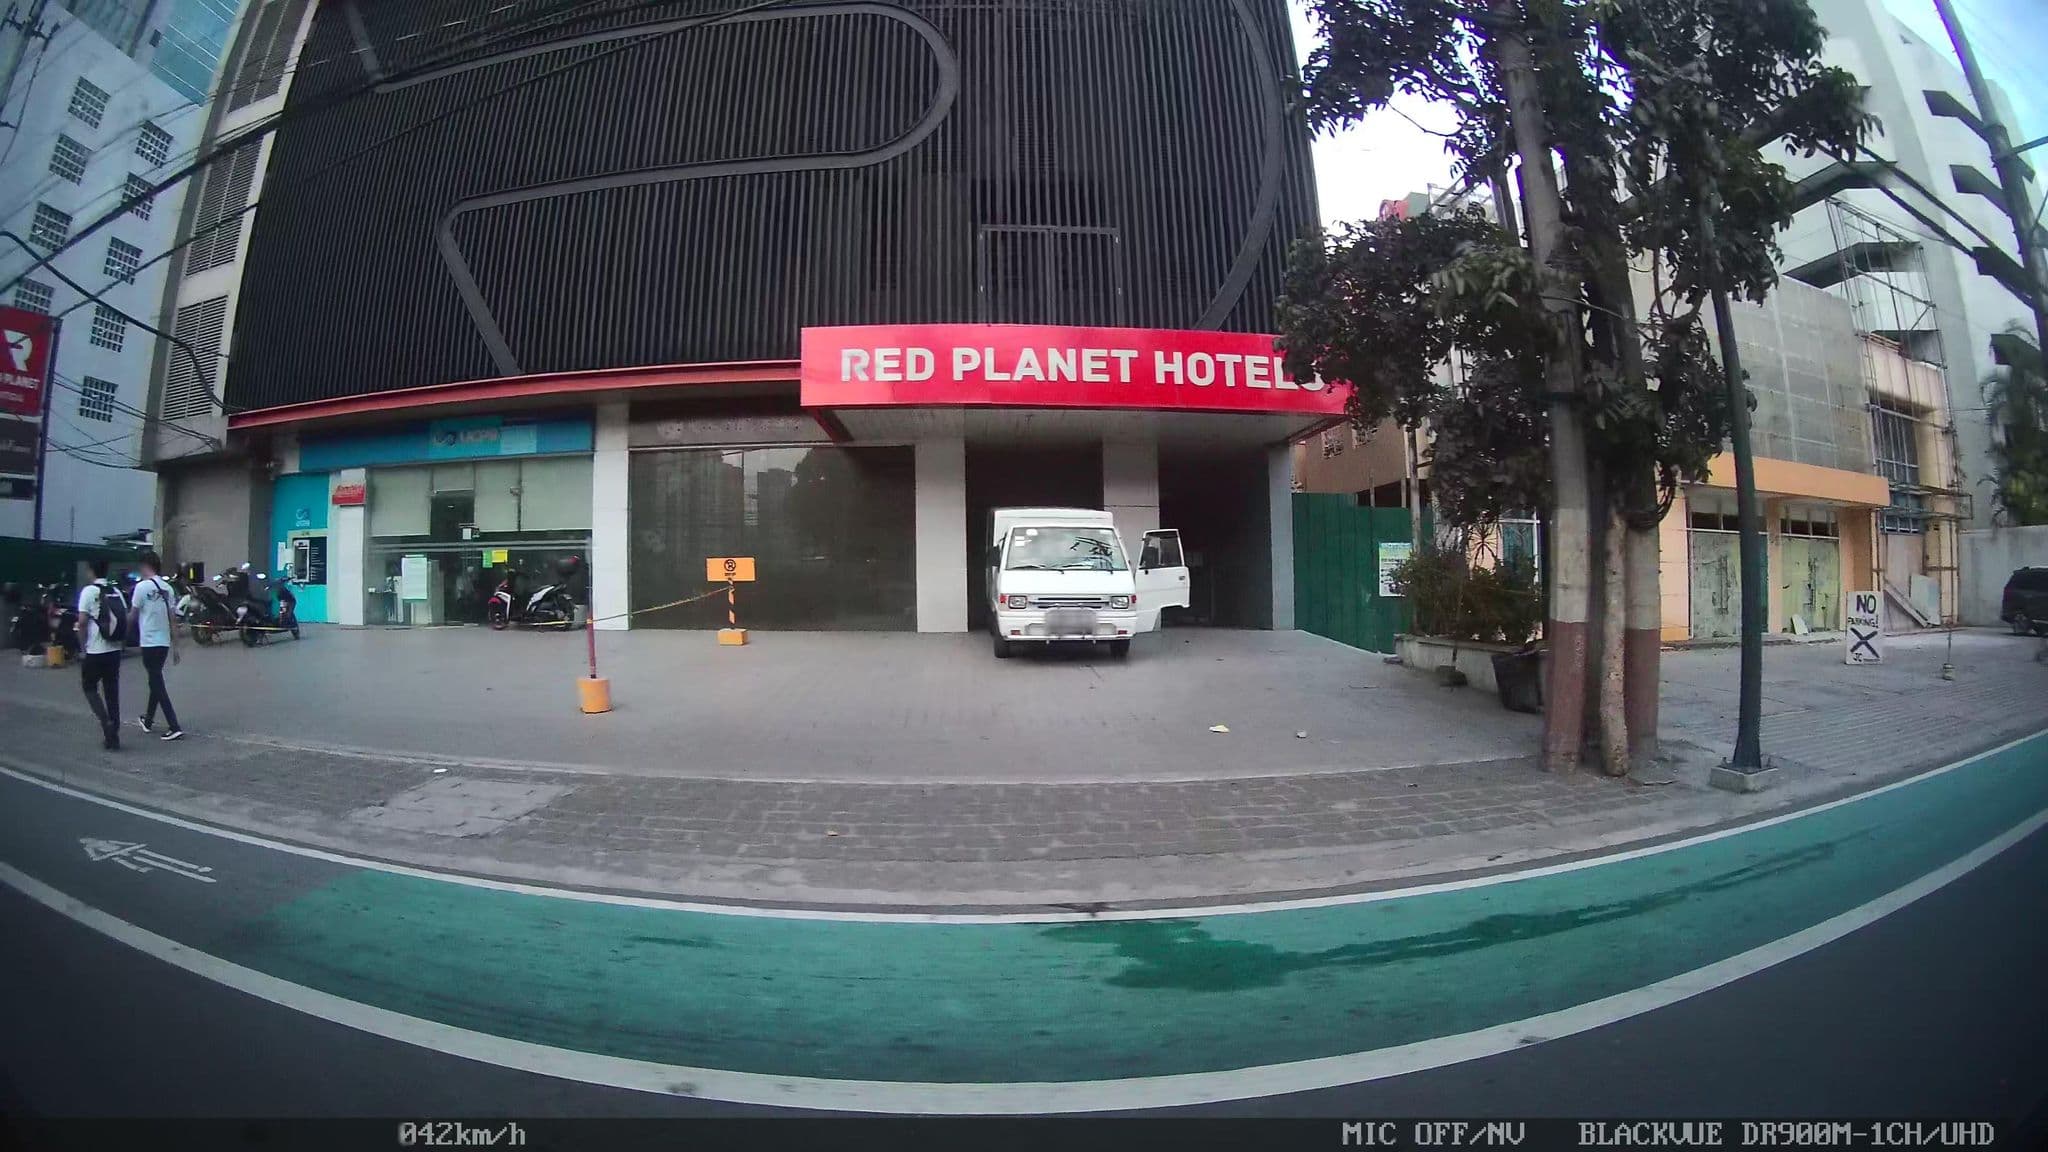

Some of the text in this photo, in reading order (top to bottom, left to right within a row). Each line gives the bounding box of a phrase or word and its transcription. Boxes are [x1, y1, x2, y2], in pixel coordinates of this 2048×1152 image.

[841, 347, 935, 381] RED
[952, 347, 1138, 383] PLANET
[1856, 594, 1876, 614] NO
